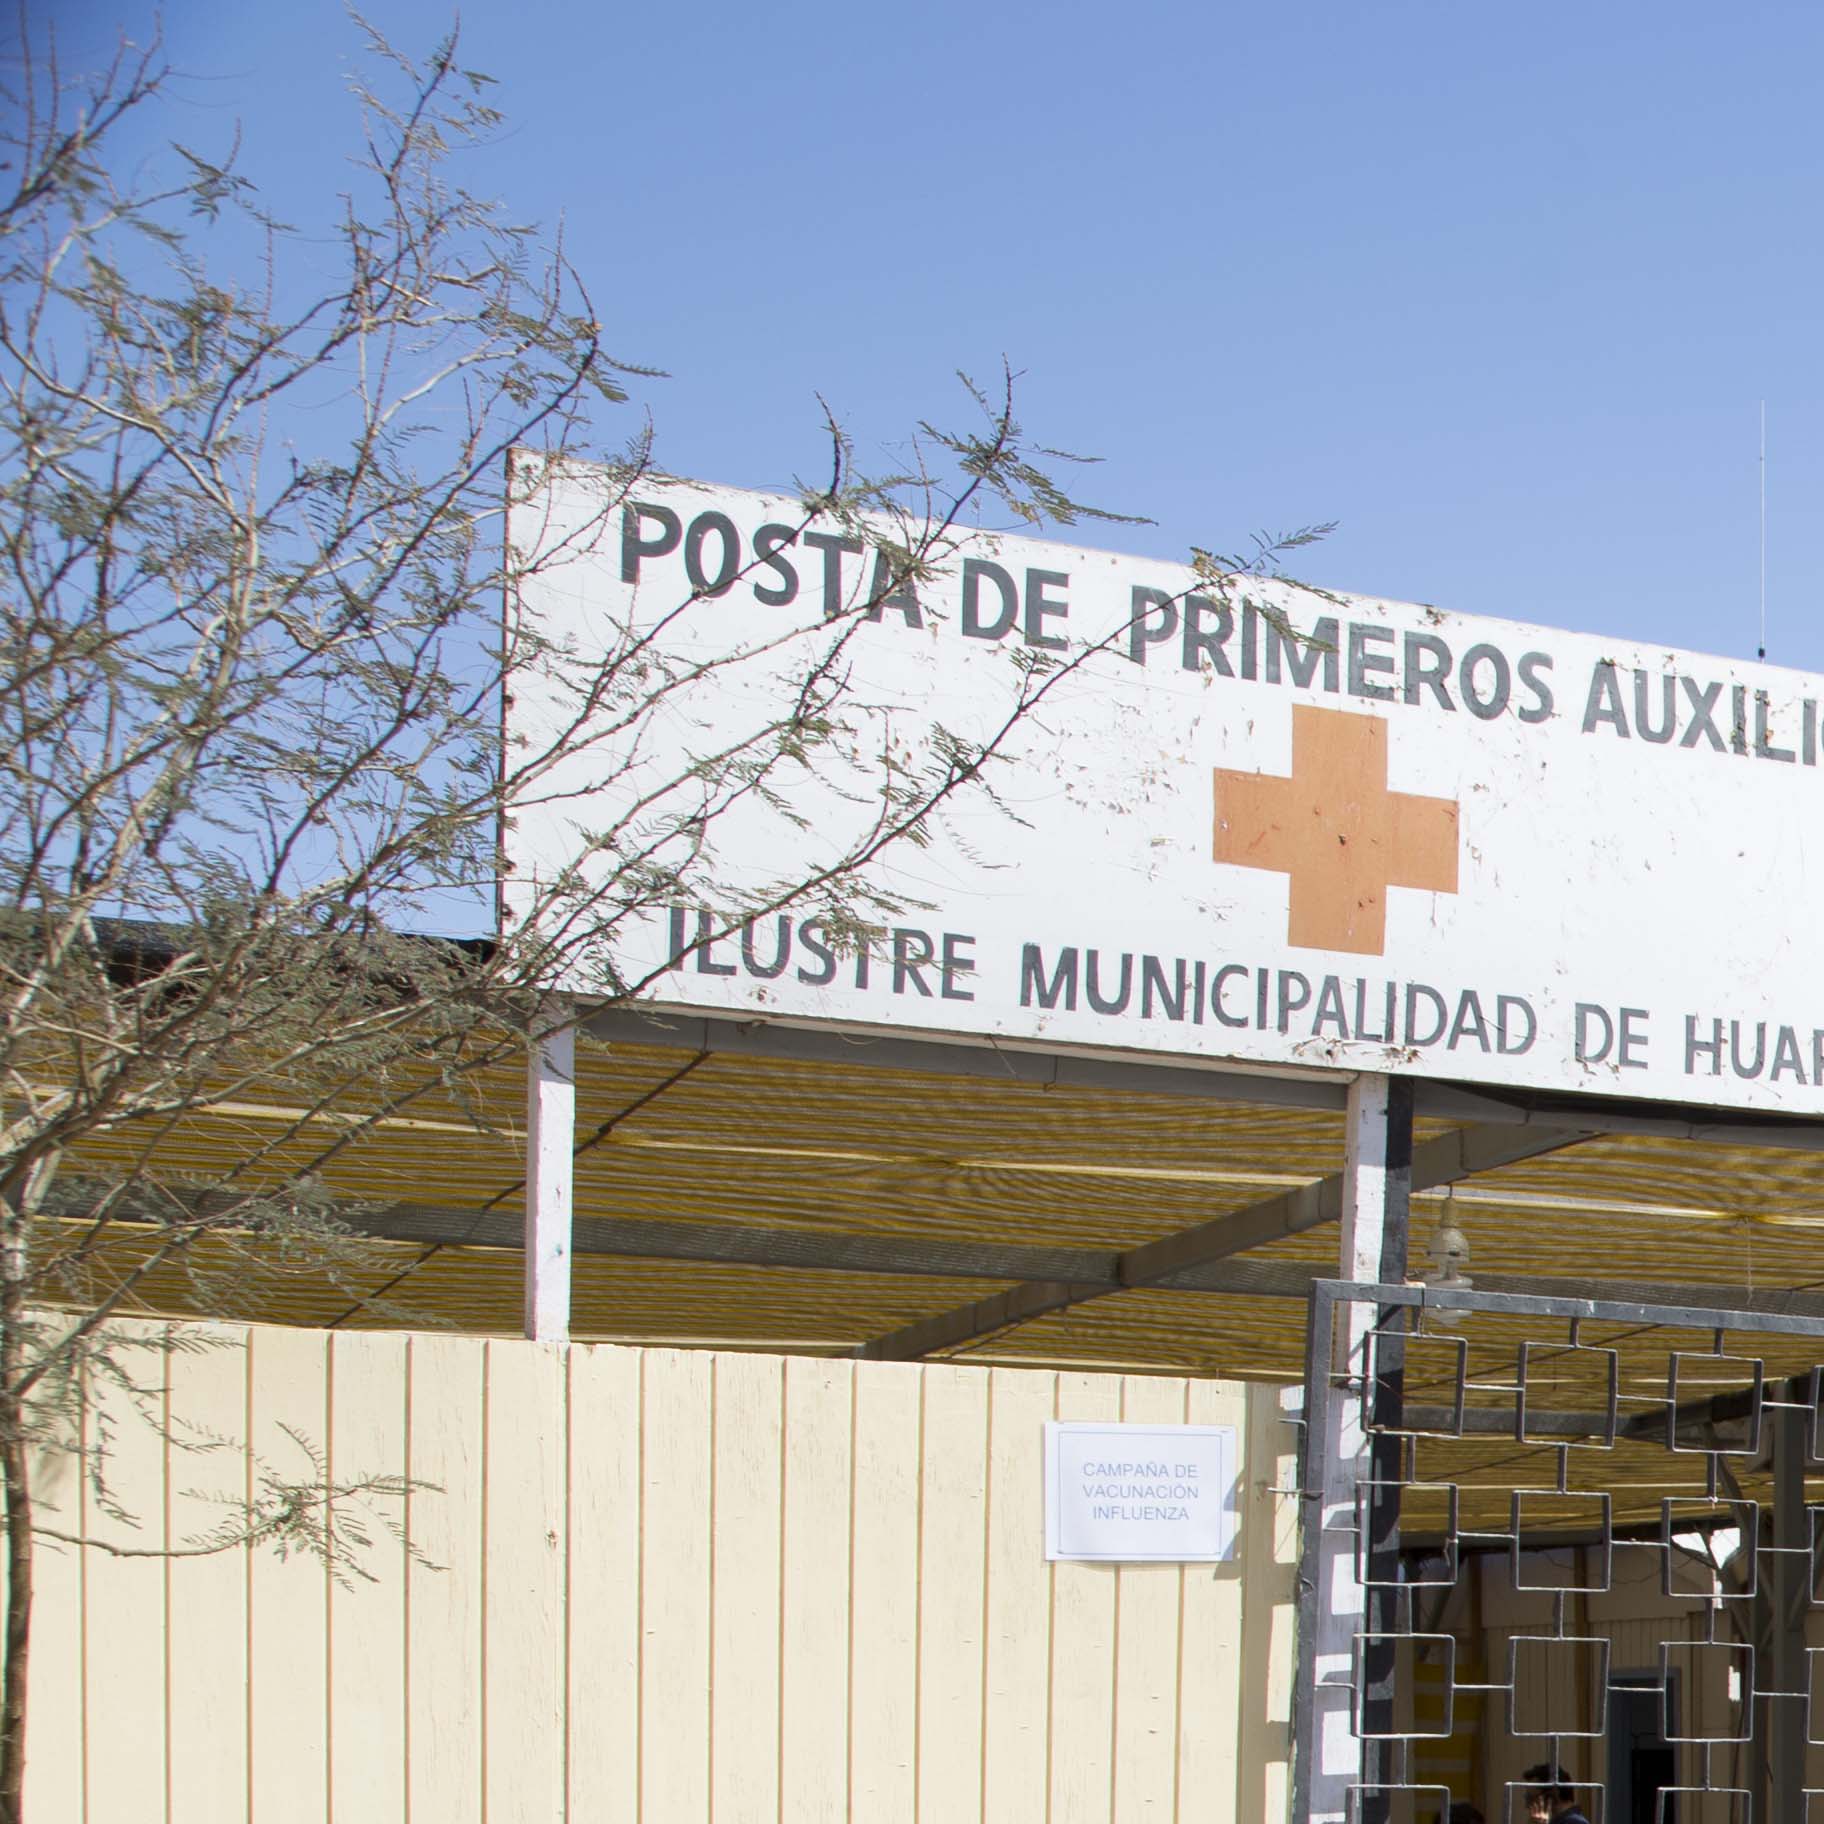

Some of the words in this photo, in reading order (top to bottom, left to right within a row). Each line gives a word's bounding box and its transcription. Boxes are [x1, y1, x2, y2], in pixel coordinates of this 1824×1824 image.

[620, 500, 924, 630] POSTA
[961, 557, 1070, 651] DE
[1130, 584, 1554, 724] PRIMEROS
[668, 905, 977, 1002] ILUSTRE
[1019, 941, 1538, 1056] MUNICIPALIDAD
[1575, 1001, 1650, 1070] DE
[1082, 1460, 1170, 1478] CAMPAÑA
[1174, 1463, 1200, 1478] DE
[1082, 1481, 1199, 1499] VACUNACIÓN
[1092, 1504, 1190, 1521] INFLUENZA
